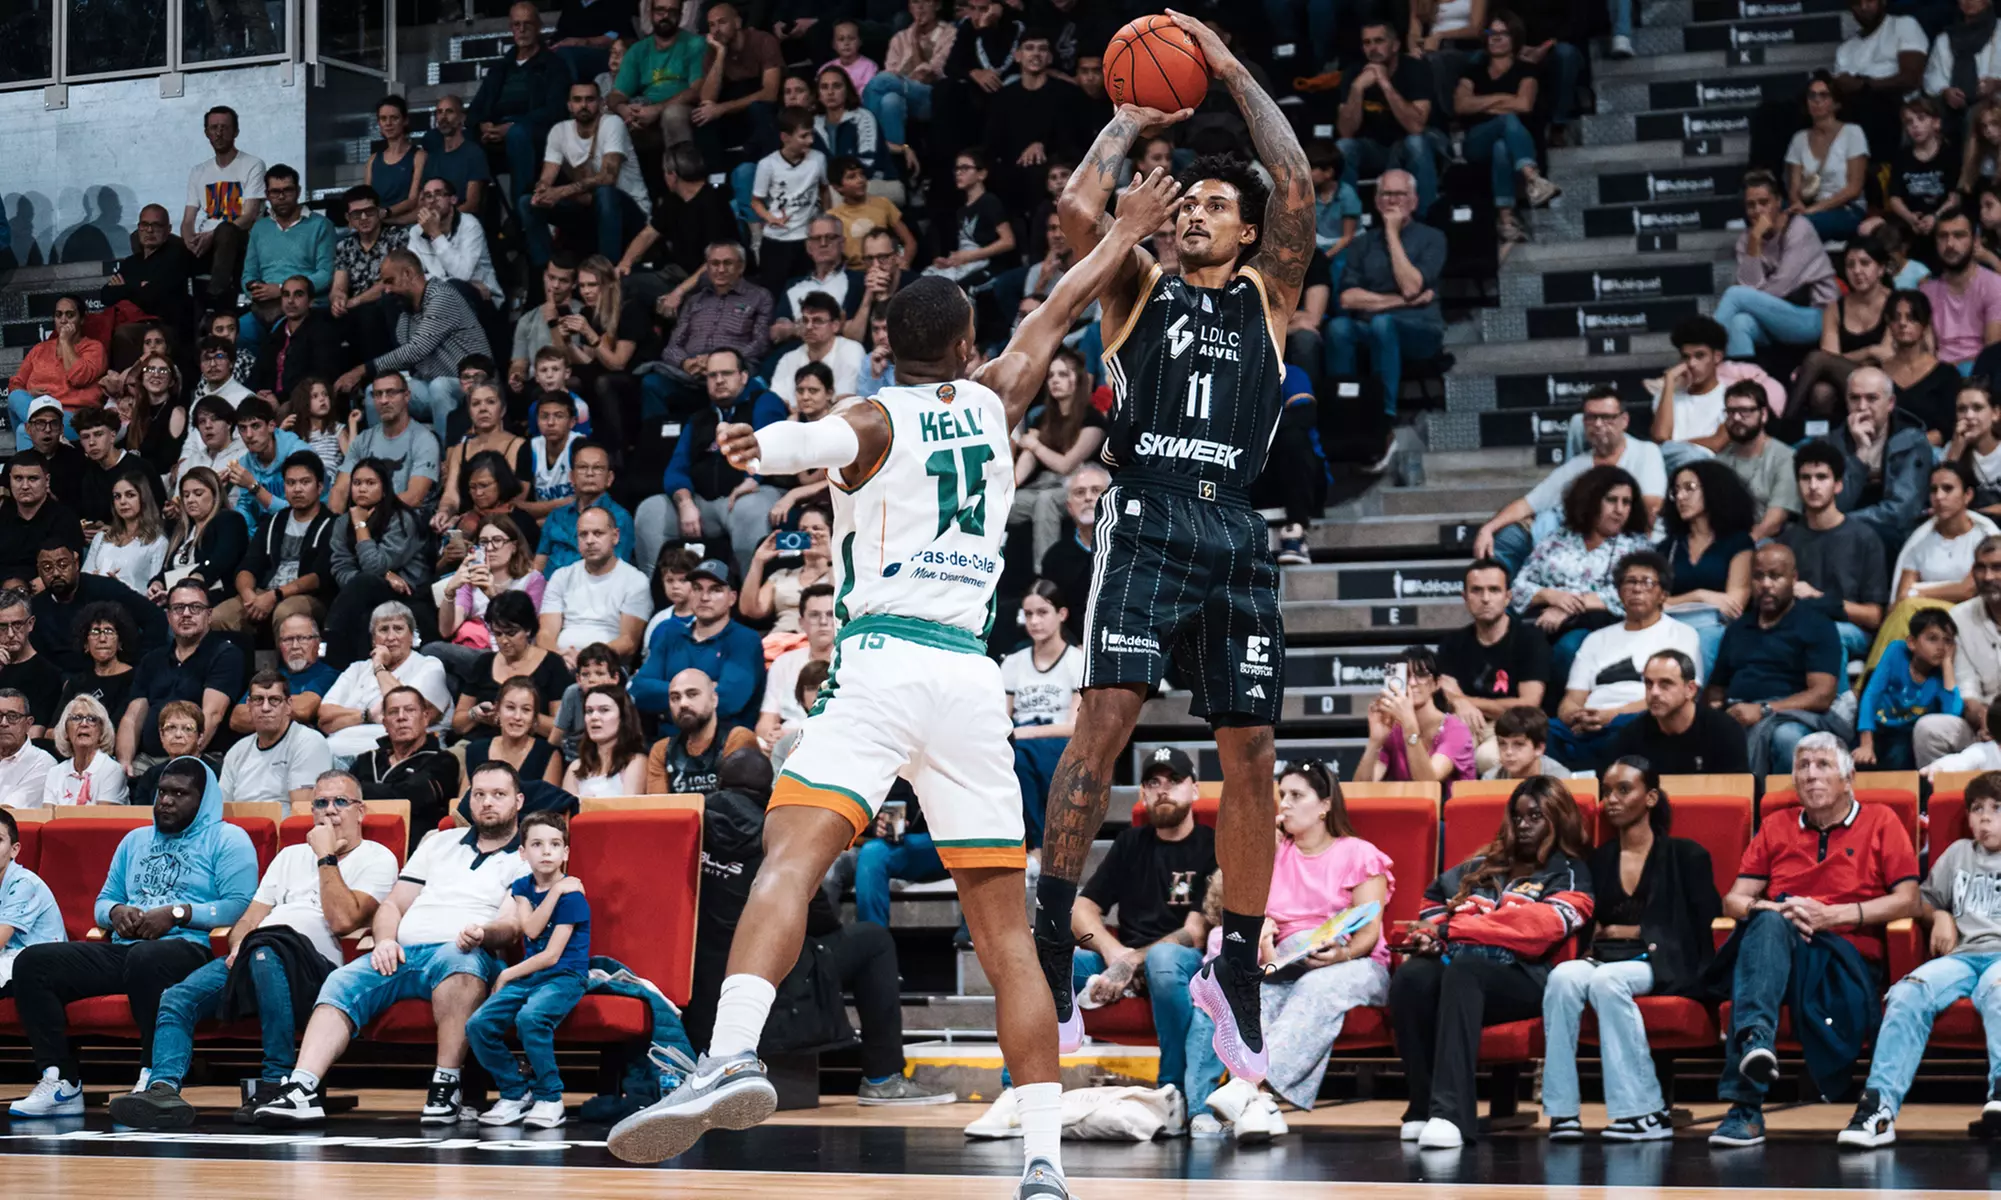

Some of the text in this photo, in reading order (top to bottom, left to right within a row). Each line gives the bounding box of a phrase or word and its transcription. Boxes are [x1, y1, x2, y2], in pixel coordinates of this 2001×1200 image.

[1697, 140, 1707, 153] J
[1200, 325, 1240, 347] LDLC
[1198, 344, 1240, 362] ASVEL
[1603, 338, 1615, 352] H
[1186, 371, 1212, 419] 11
[1134, 432, 1243, 470] SKWEEK
[925, 443, 996, 542] 15
[1456, 525, 1467, 541] F
[910, 567, 937, 579] Mon
[1389, 607, 1400, 624] E
[859, 633, 885, 650] 15
[1119, 635, 1160, 650] Adéqua
[1321, 696, 1334, 713] D
